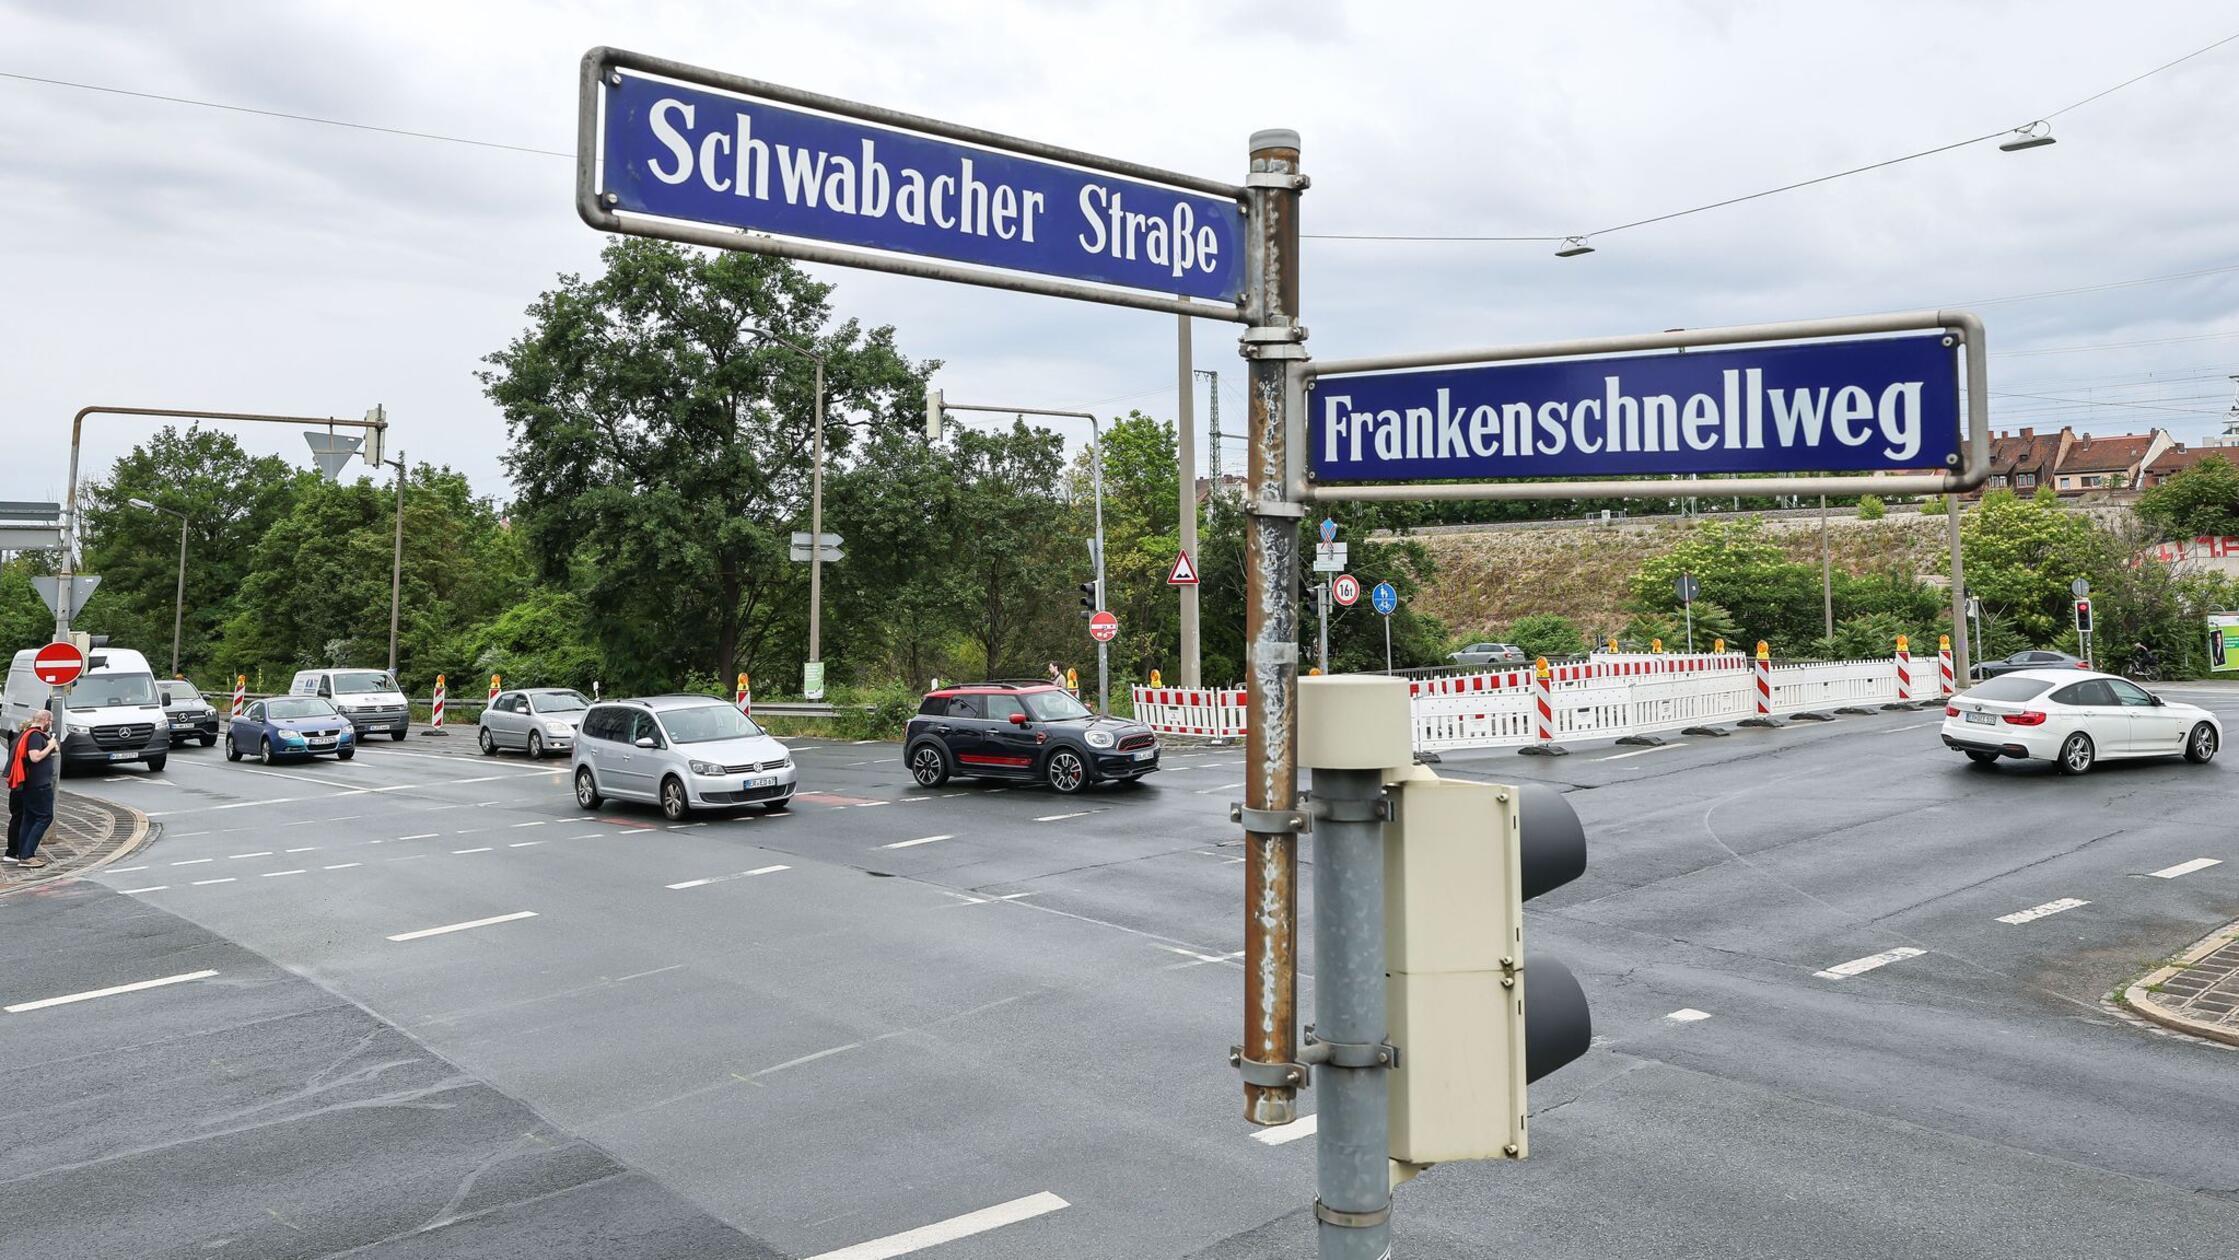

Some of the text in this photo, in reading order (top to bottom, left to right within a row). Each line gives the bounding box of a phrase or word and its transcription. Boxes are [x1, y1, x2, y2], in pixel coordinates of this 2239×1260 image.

[647, 98, 1218, 278] Schwabacher Straße
[1324, 368, 1924, 462] Frankenschnellweg
